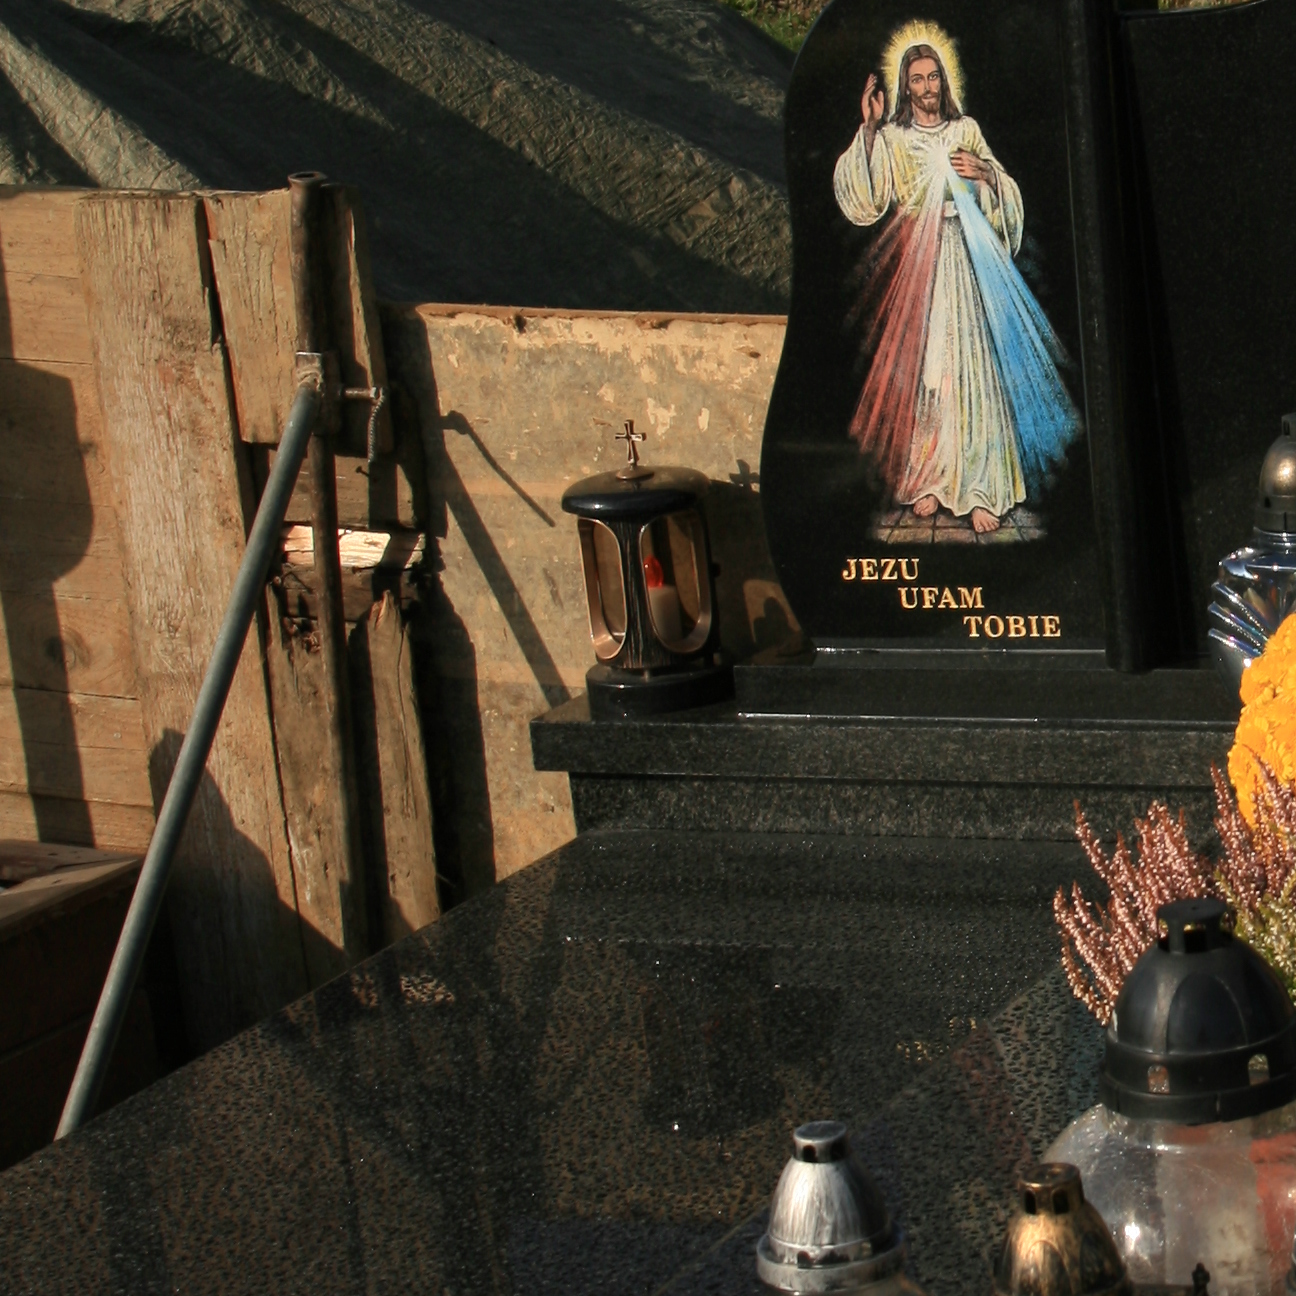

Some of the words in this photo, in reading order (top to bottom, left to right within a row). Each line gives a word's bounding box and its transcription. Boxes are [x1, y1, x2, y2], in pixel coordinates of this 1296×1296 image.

[841, 558, 919, 581] JEZU
[898, 586, 985, 609] UFAM
[963, 615, 1061, 638] TOBIE
